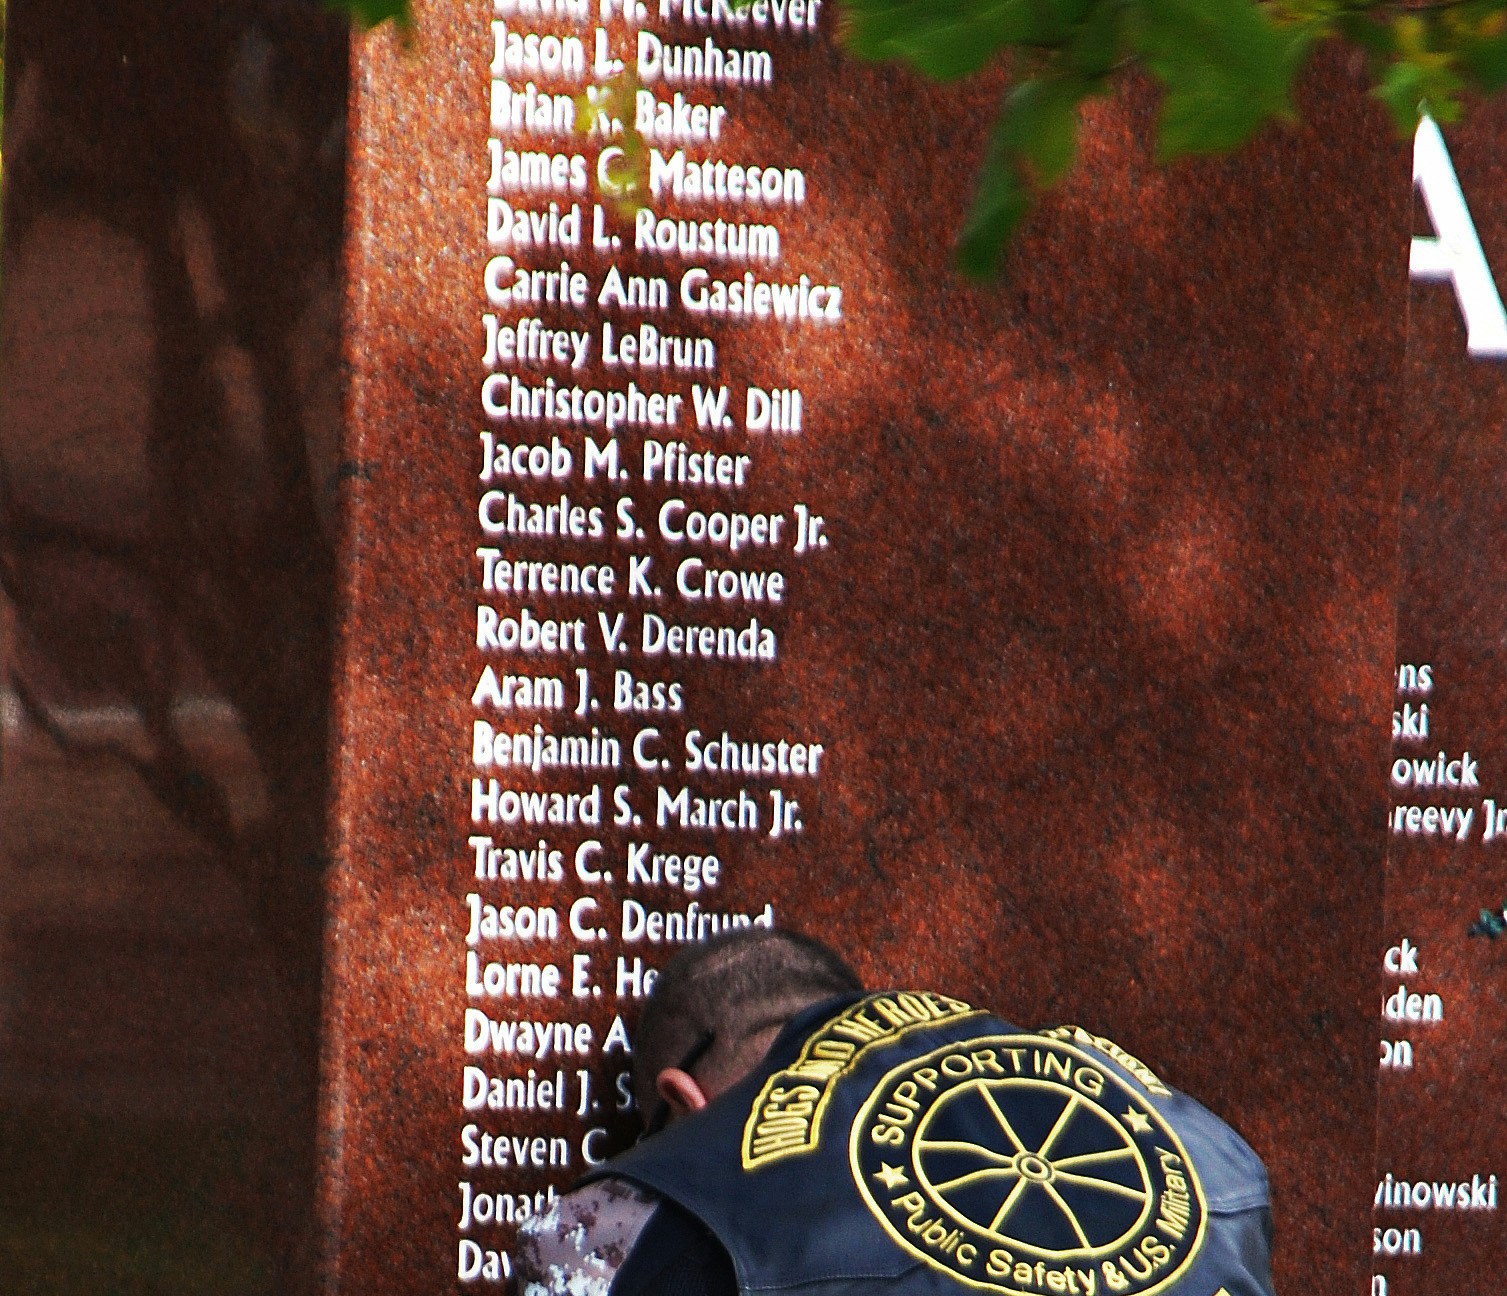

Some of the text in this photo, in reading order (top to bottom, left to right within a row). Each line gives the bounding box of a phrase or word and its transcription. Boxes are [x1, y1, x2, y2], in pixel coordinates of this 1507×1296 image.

[490, 21, 773, 82] Jason L. Dunham
[490, 78, 574, 129] Brian
[636, 89, 726, 139] Baker
[487, 138, 587, 189] James
[649, 148, 805, 203] Matteson
[487, 198, 779, 259] David L. Roustum
[484, 256, 843, 323] Carrie Ann Gasiewicz
[482, 314, 715, 369] Jeffrey LeBrun
[481, 373, 802, 433] Christopher W. Dill
[479, 431, 751, 485] Jacob M. Pfister
[478, 491, 829, 553] Charles S. Cooper Jr.
[476, 548, 784, 601] Terrence K. Crowe
[476, 606, 775, 659] Robert V. Derenda
[471, 665, 682, 715] Aram J. Bass
[472, 721, 824, 775] Benjamin C. Schuster
[1392, 751, 1479, 787] owick
[471, 779, 802, 837] Howard S. March Jr.
[1389, 805, 1473, 840] reevy
[469, 837, 720, 891] Travis C. Krege
[466, 897, 558, 946] Jason
[569, 899, 608, 941] C.
[466, 951, 559, 997] Lorne
[572, 955, 600, 998] E.
[1382, 985, 1443, 1021] den
[465, 1008, 592, 1058] Dwayne
[463, 1066, 563, 1110] Daniel
[576, 1070, 599, 1116] J.
[871, 1049, 1105, 1147] SUPPORTING
[461, 1124, 568, 1166] Steven
[753, 1085, 820, 1155] HOGS
[891, 1191, 977, 1266] Public
[1155, 1145, 1191, 1240] Military
